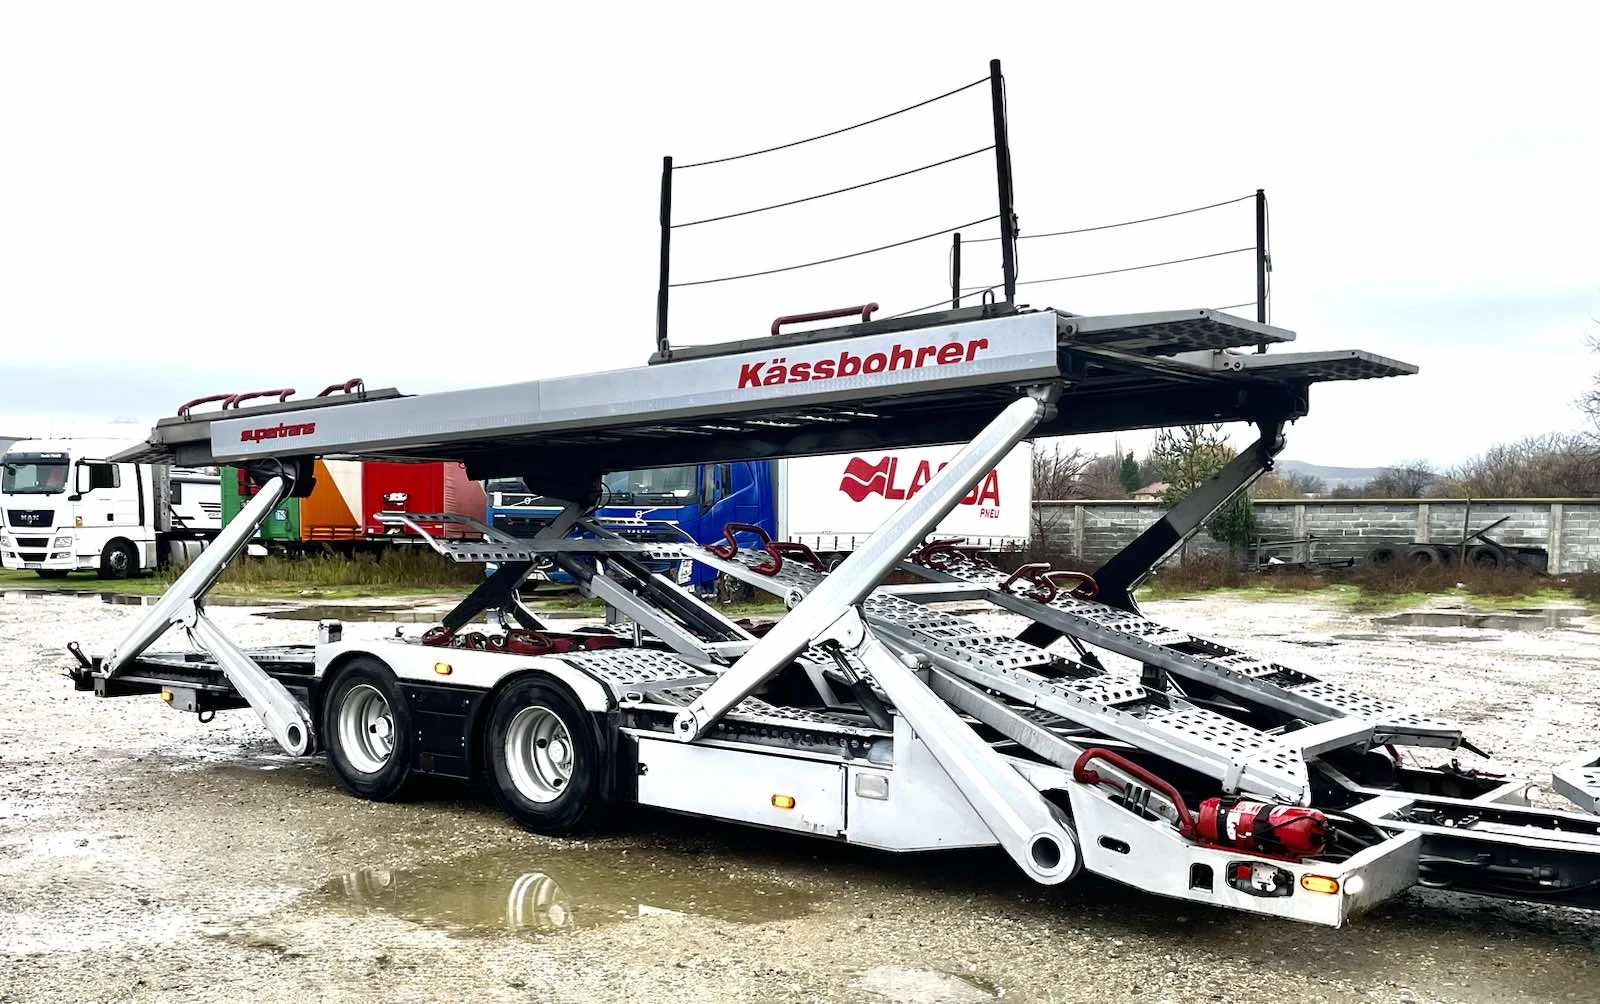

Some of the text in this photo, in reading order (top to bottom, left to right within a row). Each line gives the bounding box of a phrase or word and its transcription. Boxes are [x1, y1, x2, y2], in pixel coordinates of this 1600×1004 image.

[737, 338, 989, 389] Kässbohrer
[240, 422, 316, 443] supertrans
[884, 457, 1001, 507] LAA
[980, 508, 1001, 519] PNEU
